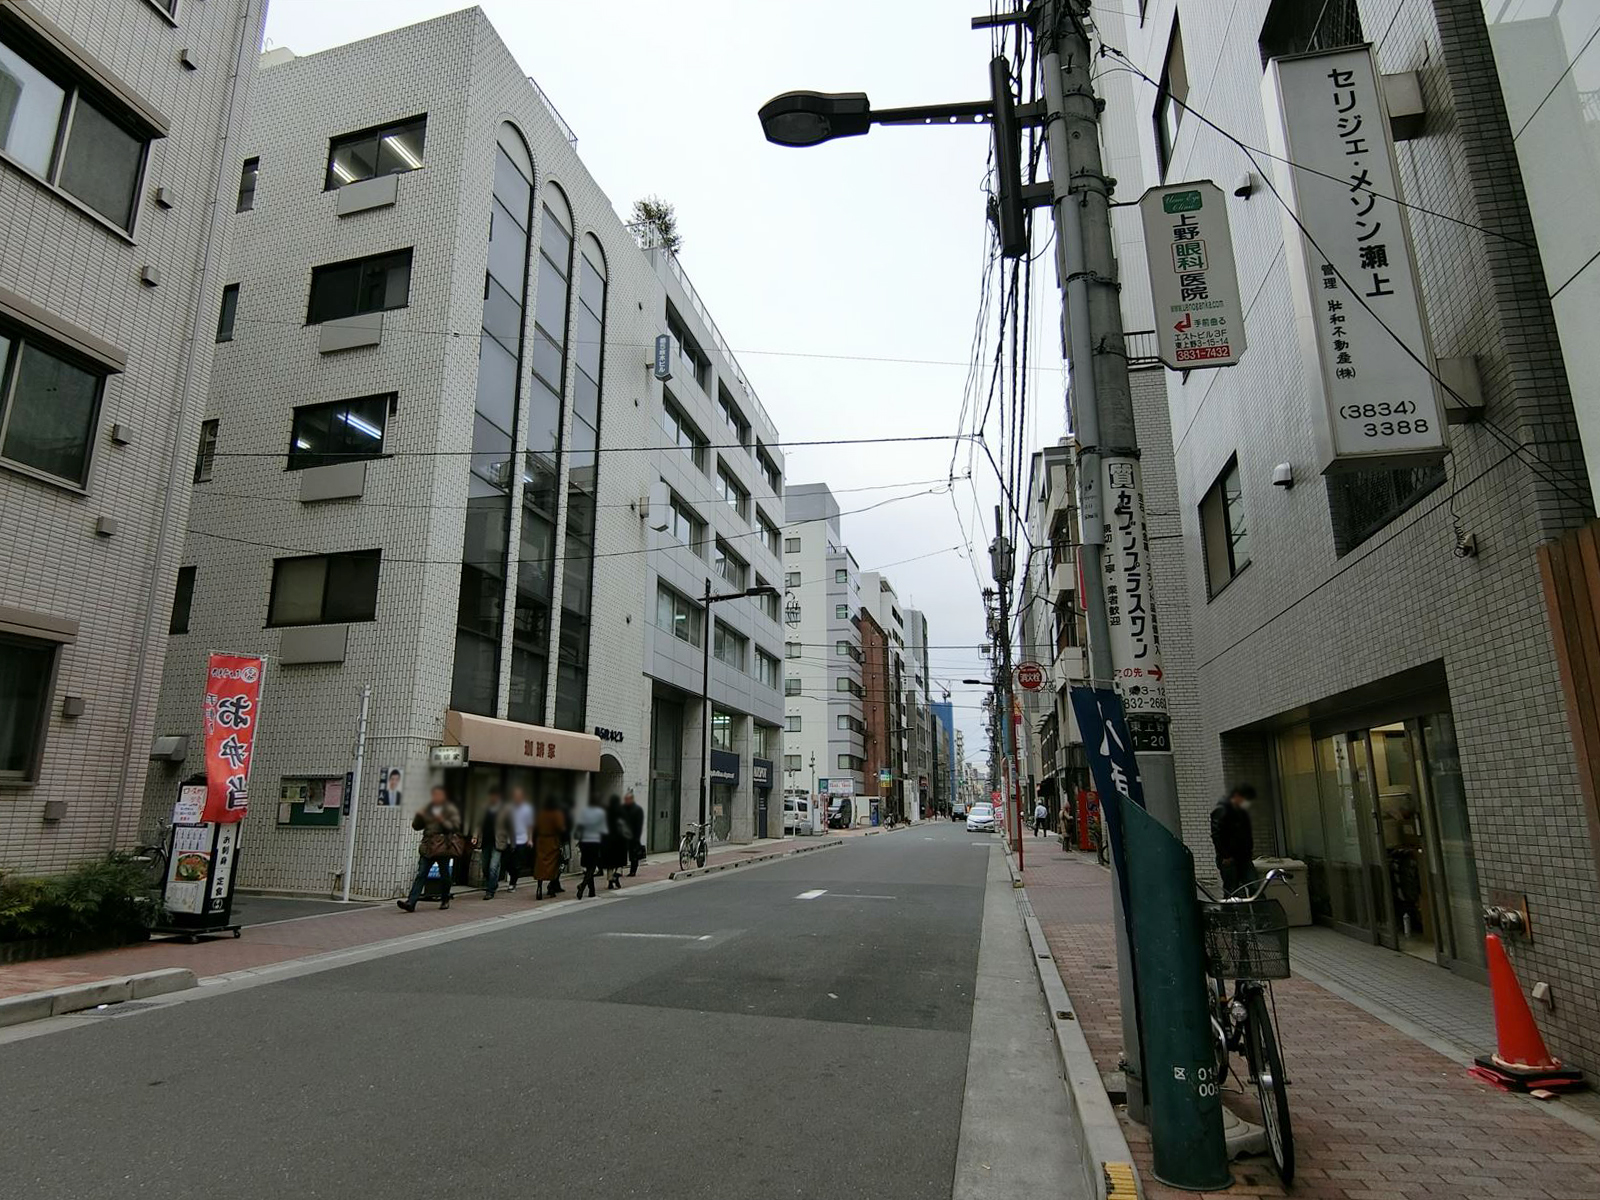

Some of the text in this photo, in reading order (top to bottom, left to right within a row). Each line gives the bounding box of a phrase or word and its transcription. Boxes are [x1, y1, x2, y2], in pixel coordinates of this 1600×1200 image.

[1172, 214, 1208, 301] 上野眼科医院
[1321, 263, 1338, 289] 管理
[1175, 337, 1229, 350] 東上野3-15-14
[1177, 347, 1229, 361] 3831-7432
[1340, 401, 1416, 419] (3834)
[1364, 419, 1429, 437] 3388
[1117, 490, 1147, 659] セブンプラスワン
[1020, 673, 1040, 682] 消火栓
[1130, 721, 1165, 732] 東上野
[1132, 735, 1165, 747] 1-20
